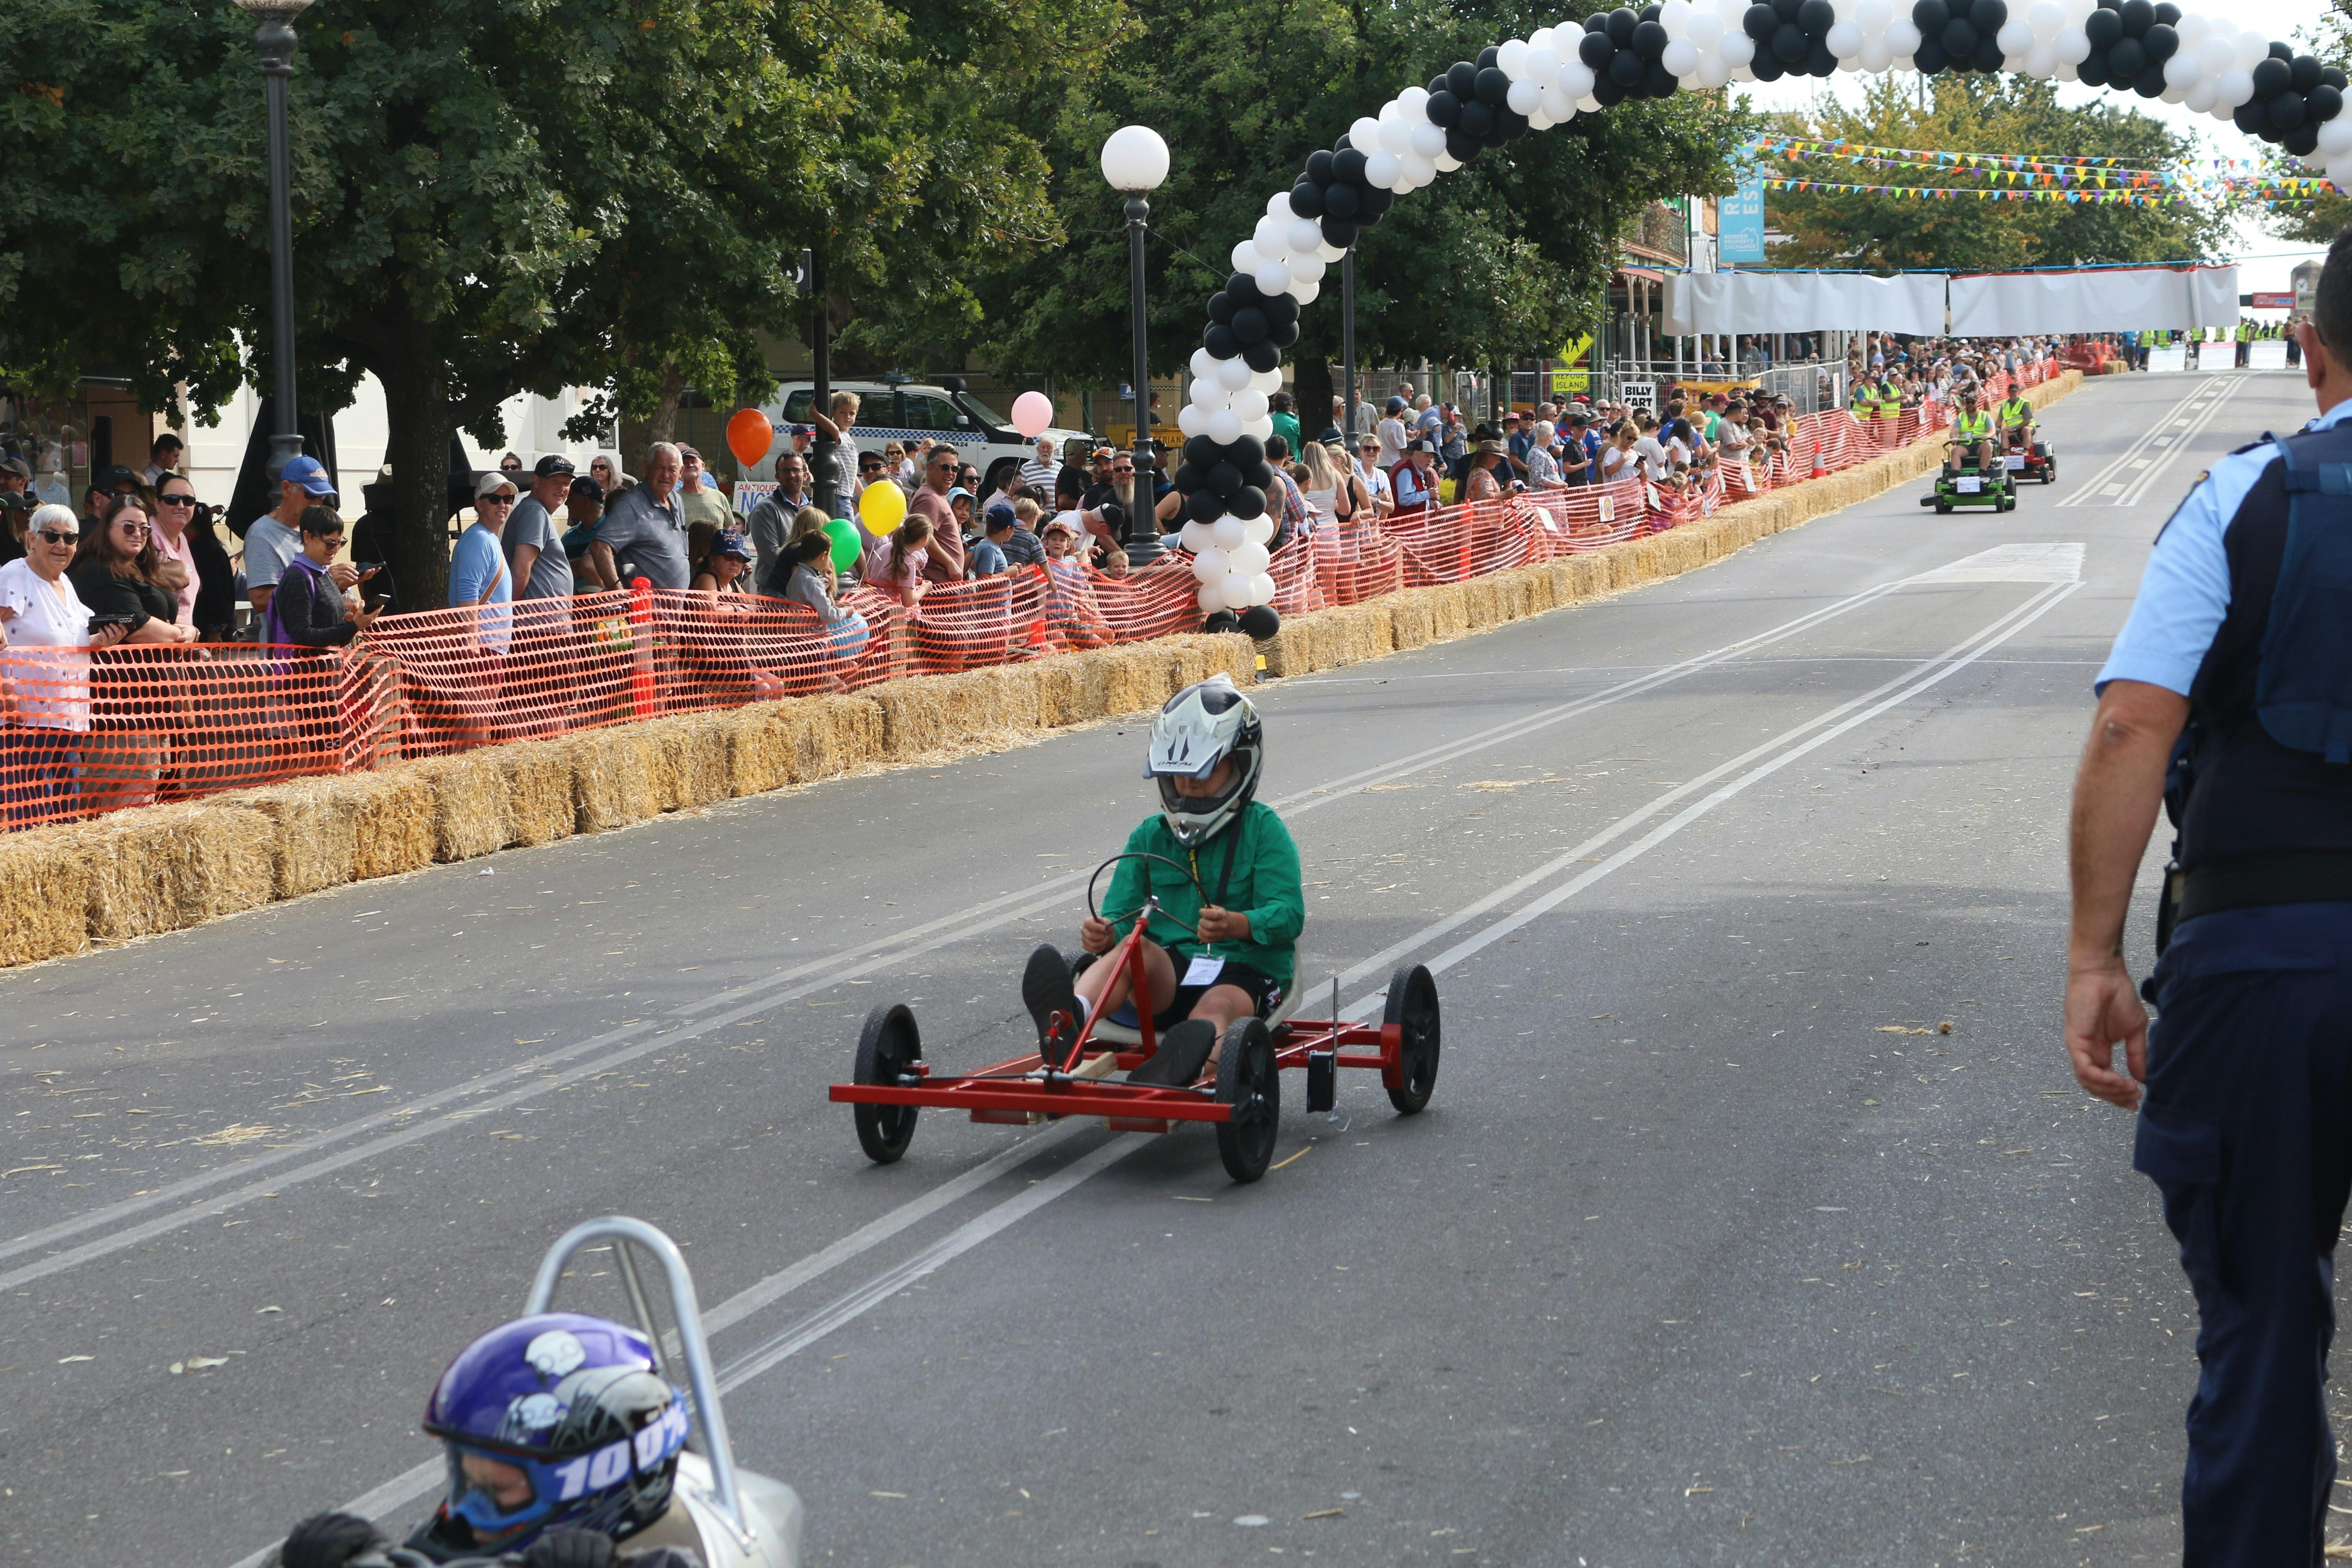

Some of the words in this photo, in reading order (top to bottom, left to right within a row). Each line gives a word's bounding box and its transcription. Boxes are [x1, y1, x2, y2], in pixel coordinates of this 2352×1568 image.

[1625, 386, 1652, 395] BILLY
[1624, 398, 1652, 407] CART
[554, 1400, 687, 1501] 100%
